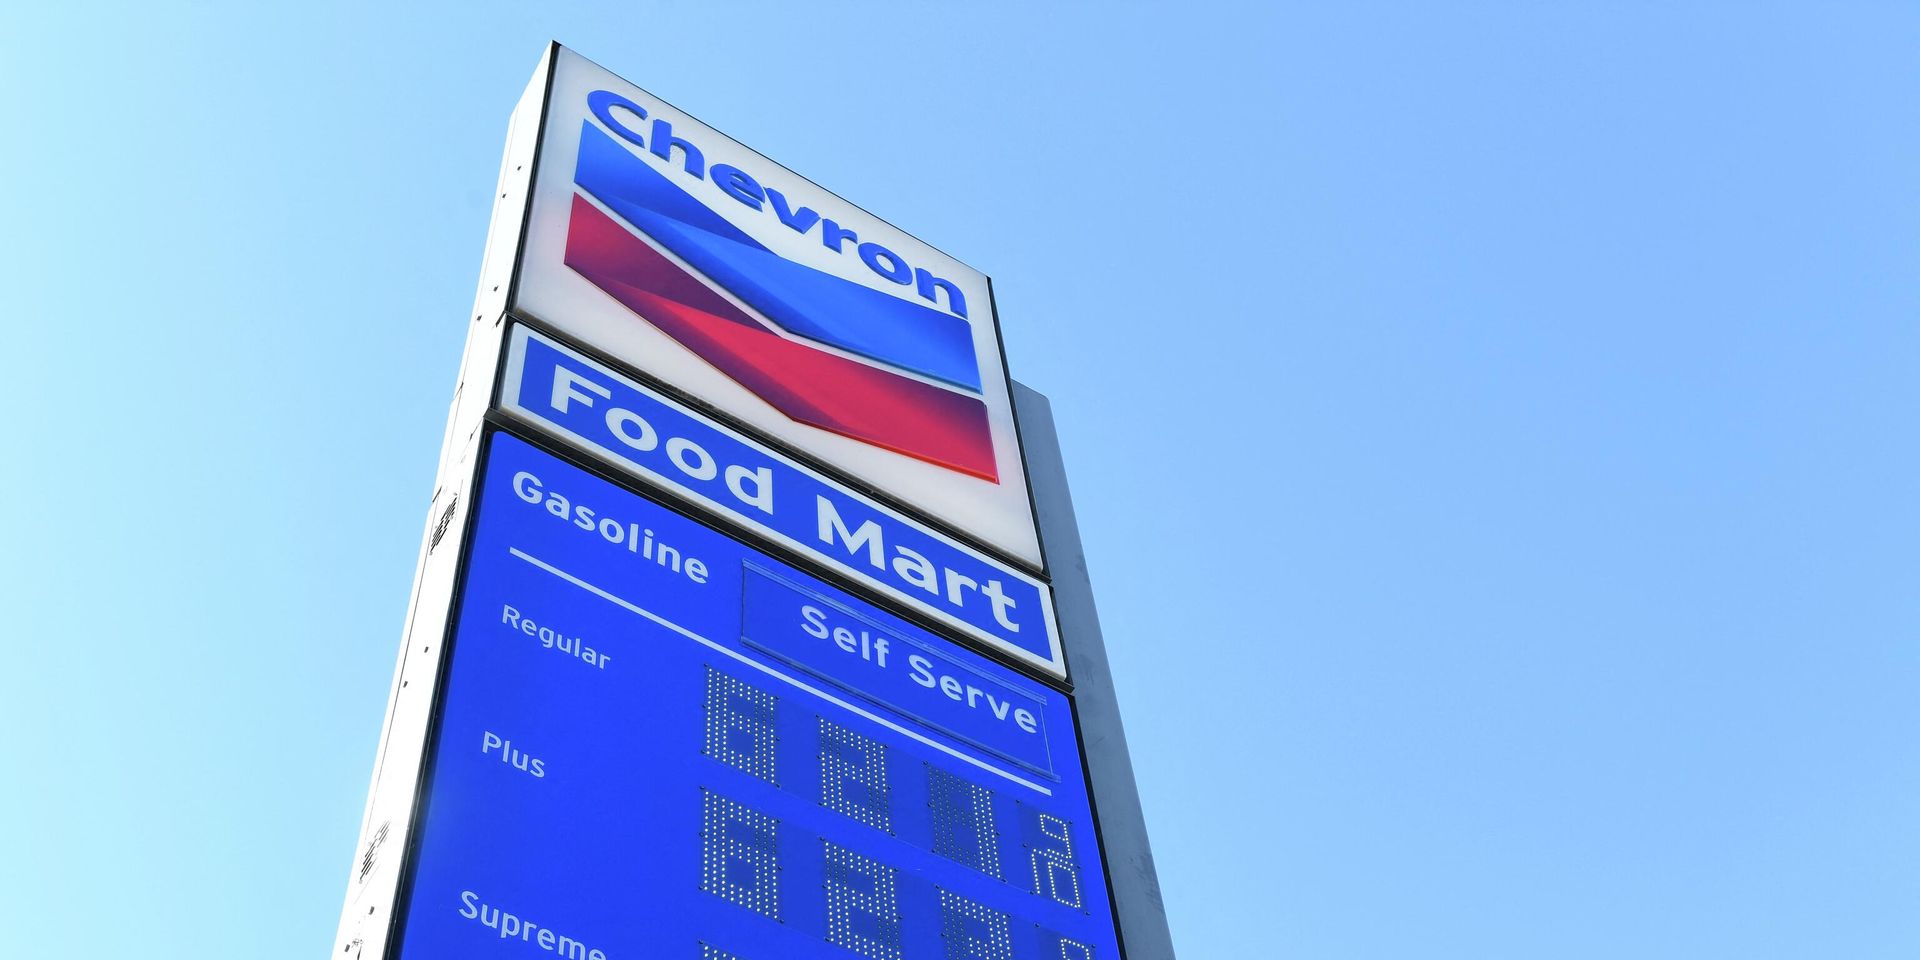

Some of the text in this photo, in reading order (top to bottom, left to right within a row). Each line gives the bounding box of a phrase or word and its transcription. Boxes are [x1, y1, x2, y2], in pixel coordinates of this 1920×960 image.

[587, 89, 968, 320] Chevron
[512, 471, 709, 584] Gasoline
[551, 365, 1020, 633] Food Mart
[502, 604, 611, 669] Regular
[801, 605, 1038, 734] Self Serve
[482, 731, 545, 778] Plus
[458, 890, 607, 960] Supreme
